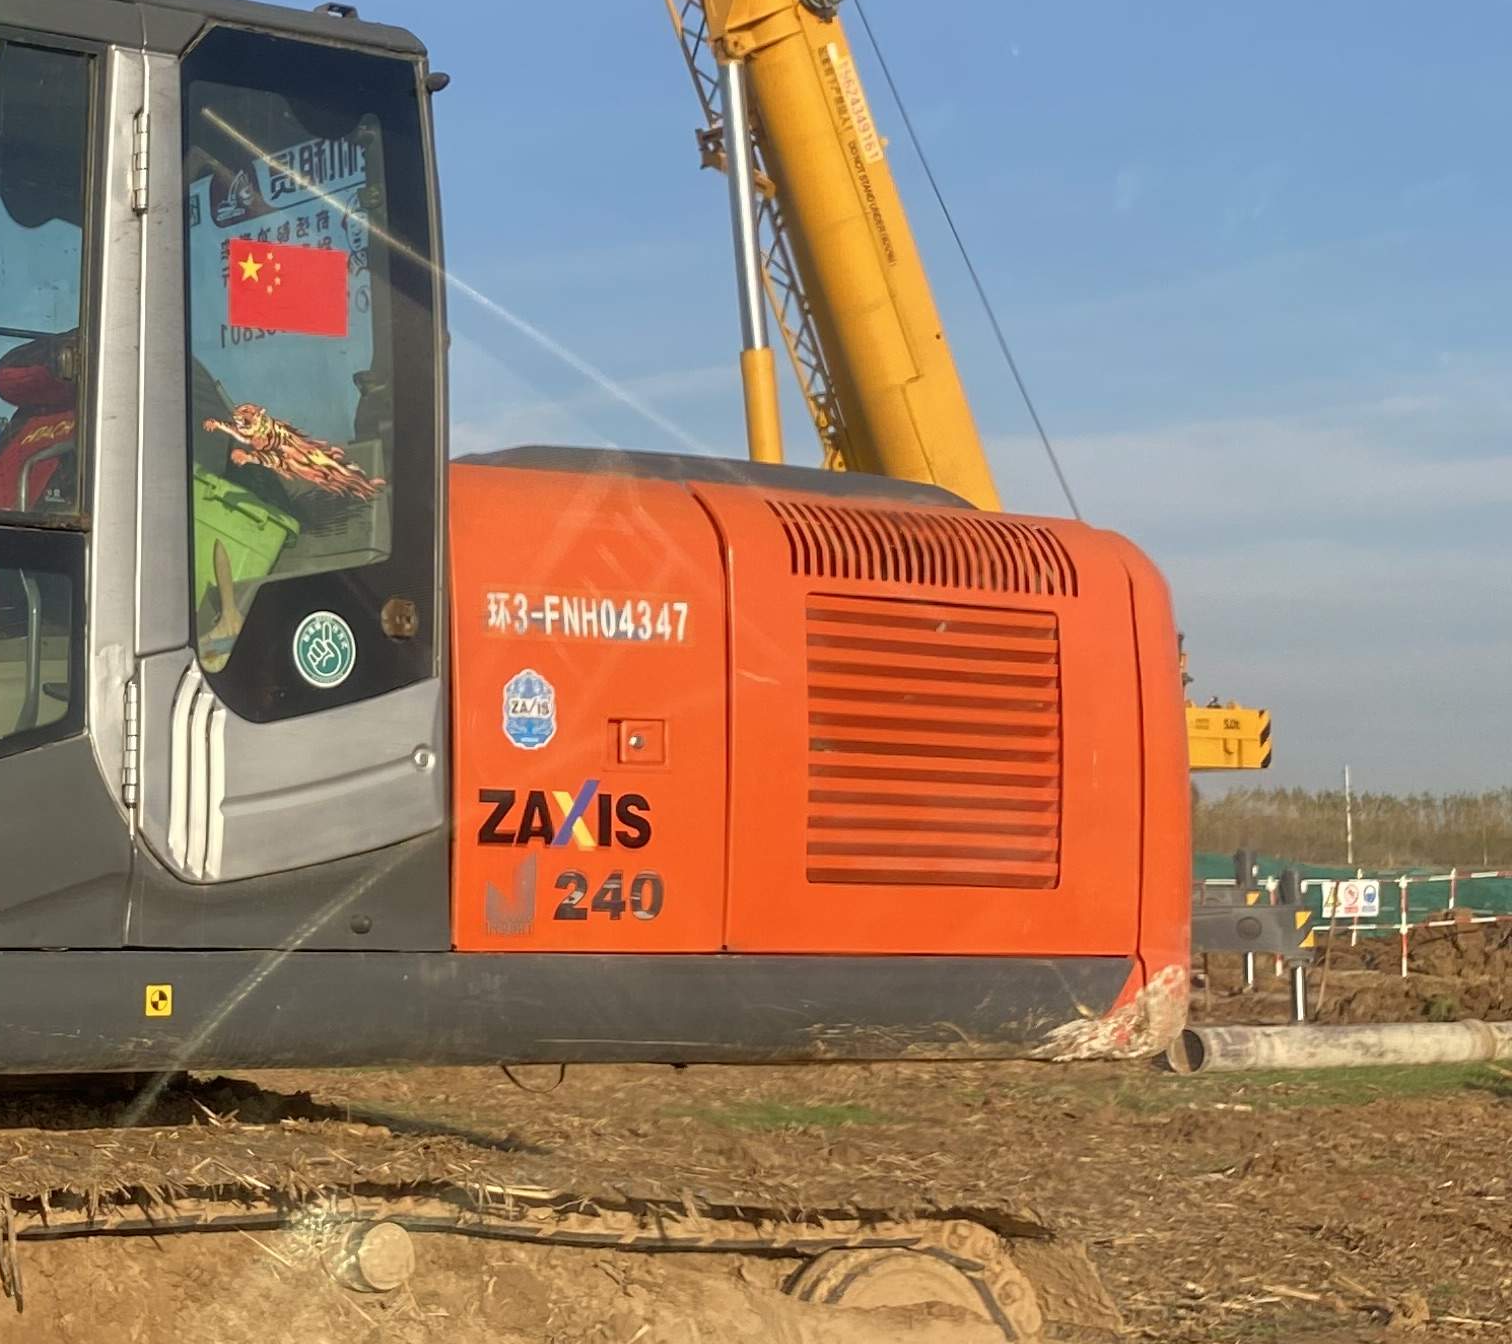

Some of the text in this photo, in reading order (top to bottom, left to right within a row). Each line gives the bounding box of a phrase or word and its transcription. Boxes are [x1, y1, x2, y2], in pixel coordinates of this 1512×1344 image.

[486, 590, 690, 643] 环3-FNH04347
[476, 778, 653, 852] ZAXIS
[552, 869, 665, 922] 240
